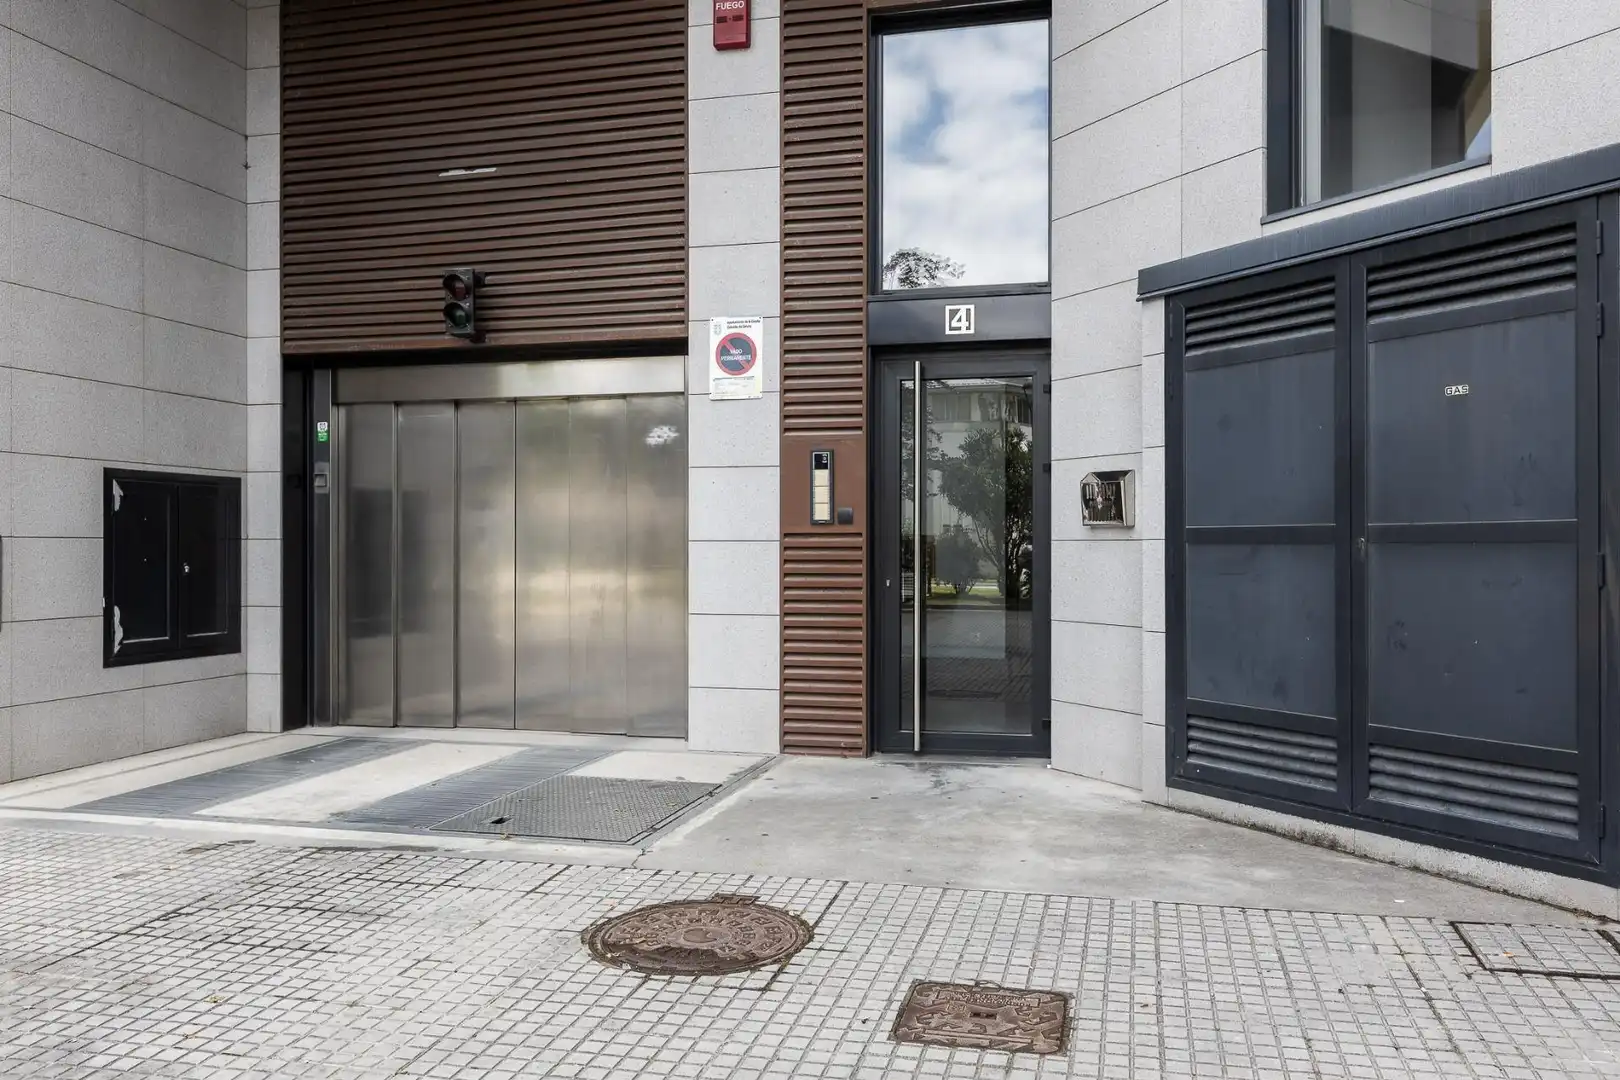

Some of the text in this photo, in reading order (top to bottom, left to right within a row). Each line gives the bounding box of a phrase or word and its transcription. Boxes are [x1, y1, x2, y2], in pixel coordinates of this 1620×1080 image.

[715, 1, 745, 10] FUEGO
[950, 306, 970, 332] 4
[1445, 385, 1469, 396] GAS
